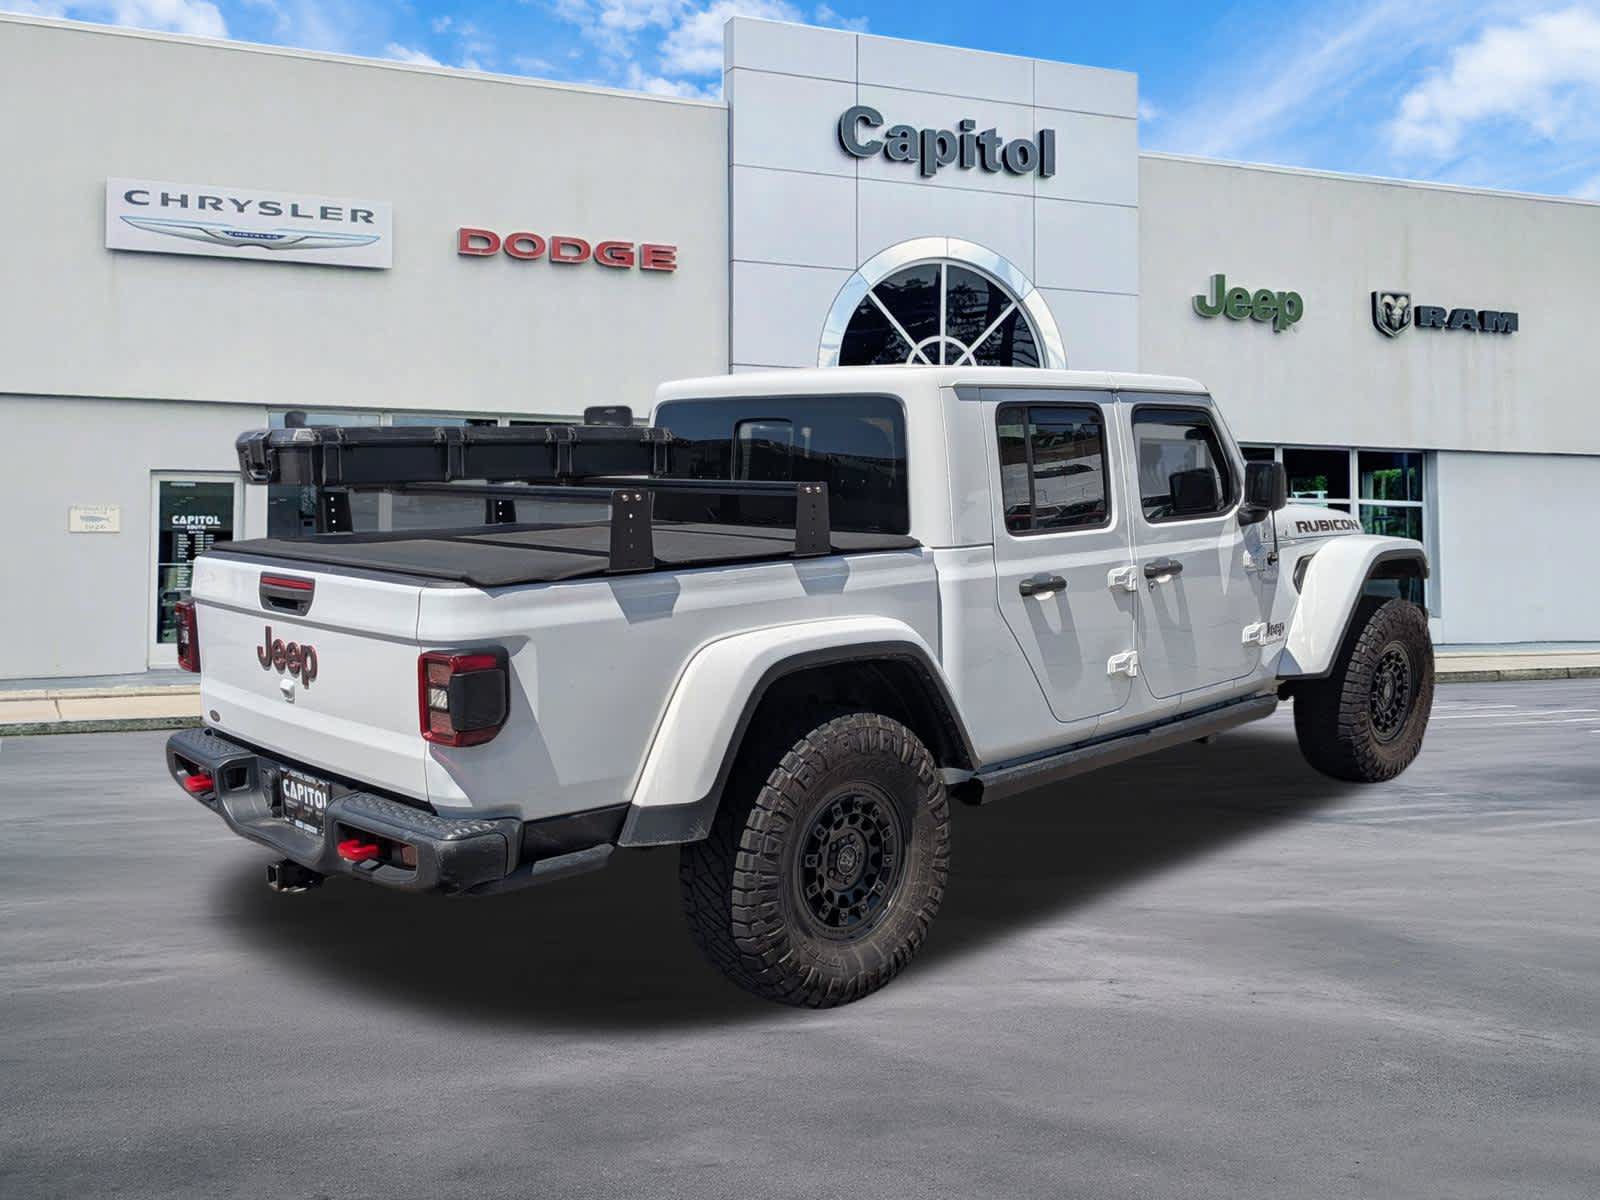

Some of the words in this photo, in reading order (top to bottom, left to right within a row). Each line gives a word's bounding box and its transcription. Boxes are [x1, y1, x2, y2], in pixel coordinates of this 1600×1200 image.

[838, 105, 1056, 177] Capitol
[123, 189, 375, 224] CHRYSLER
[457, 227, 678, 273] DODGE
[1192, 274, 1304, 333] Jeep
[1414, 304, 1519, 334] RAM
[171, 515, 221, 525] CAPITOL
[1295, 519, 1360, 534] RUBICON
[256, 625, 318, 690] Jeep
